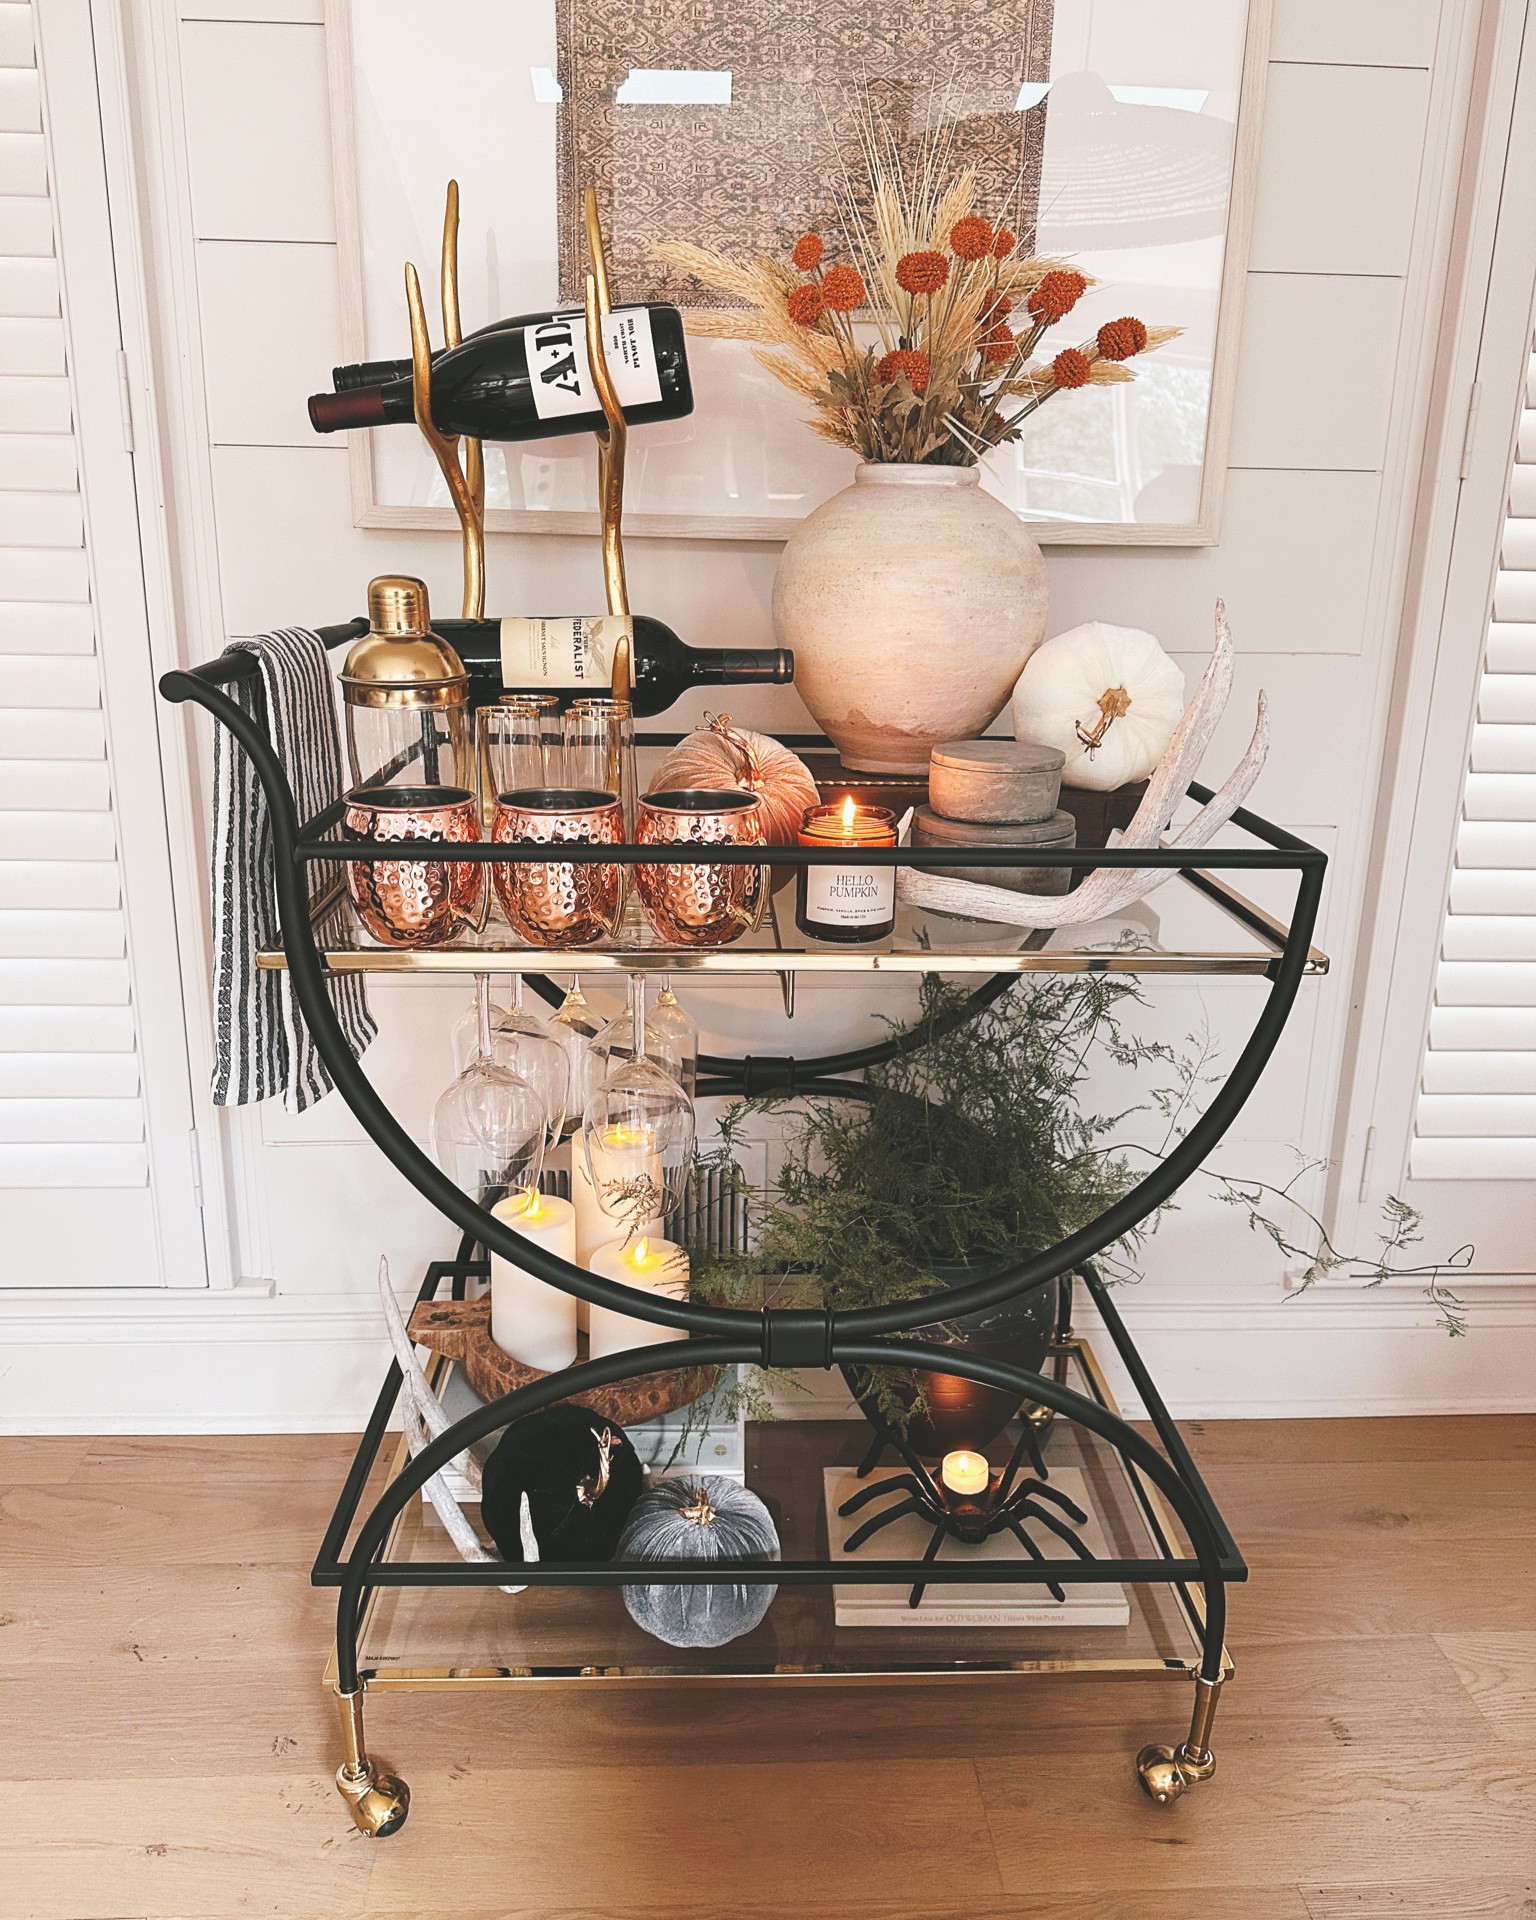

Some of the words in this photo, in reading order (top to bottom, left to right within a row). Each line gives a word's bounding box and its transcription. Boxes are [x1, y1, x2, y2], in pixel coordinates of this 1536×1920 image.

[627, 318, 635, 336] NOIR
[621, 340, 629, 364] NORTH
[629, 338, 640, 369] PINOT
[573, 618, 584, 680] FEDERALIST
[836, 874, 874, 886] HELLO
[829, 886, 878, 898] PUMPKIN
